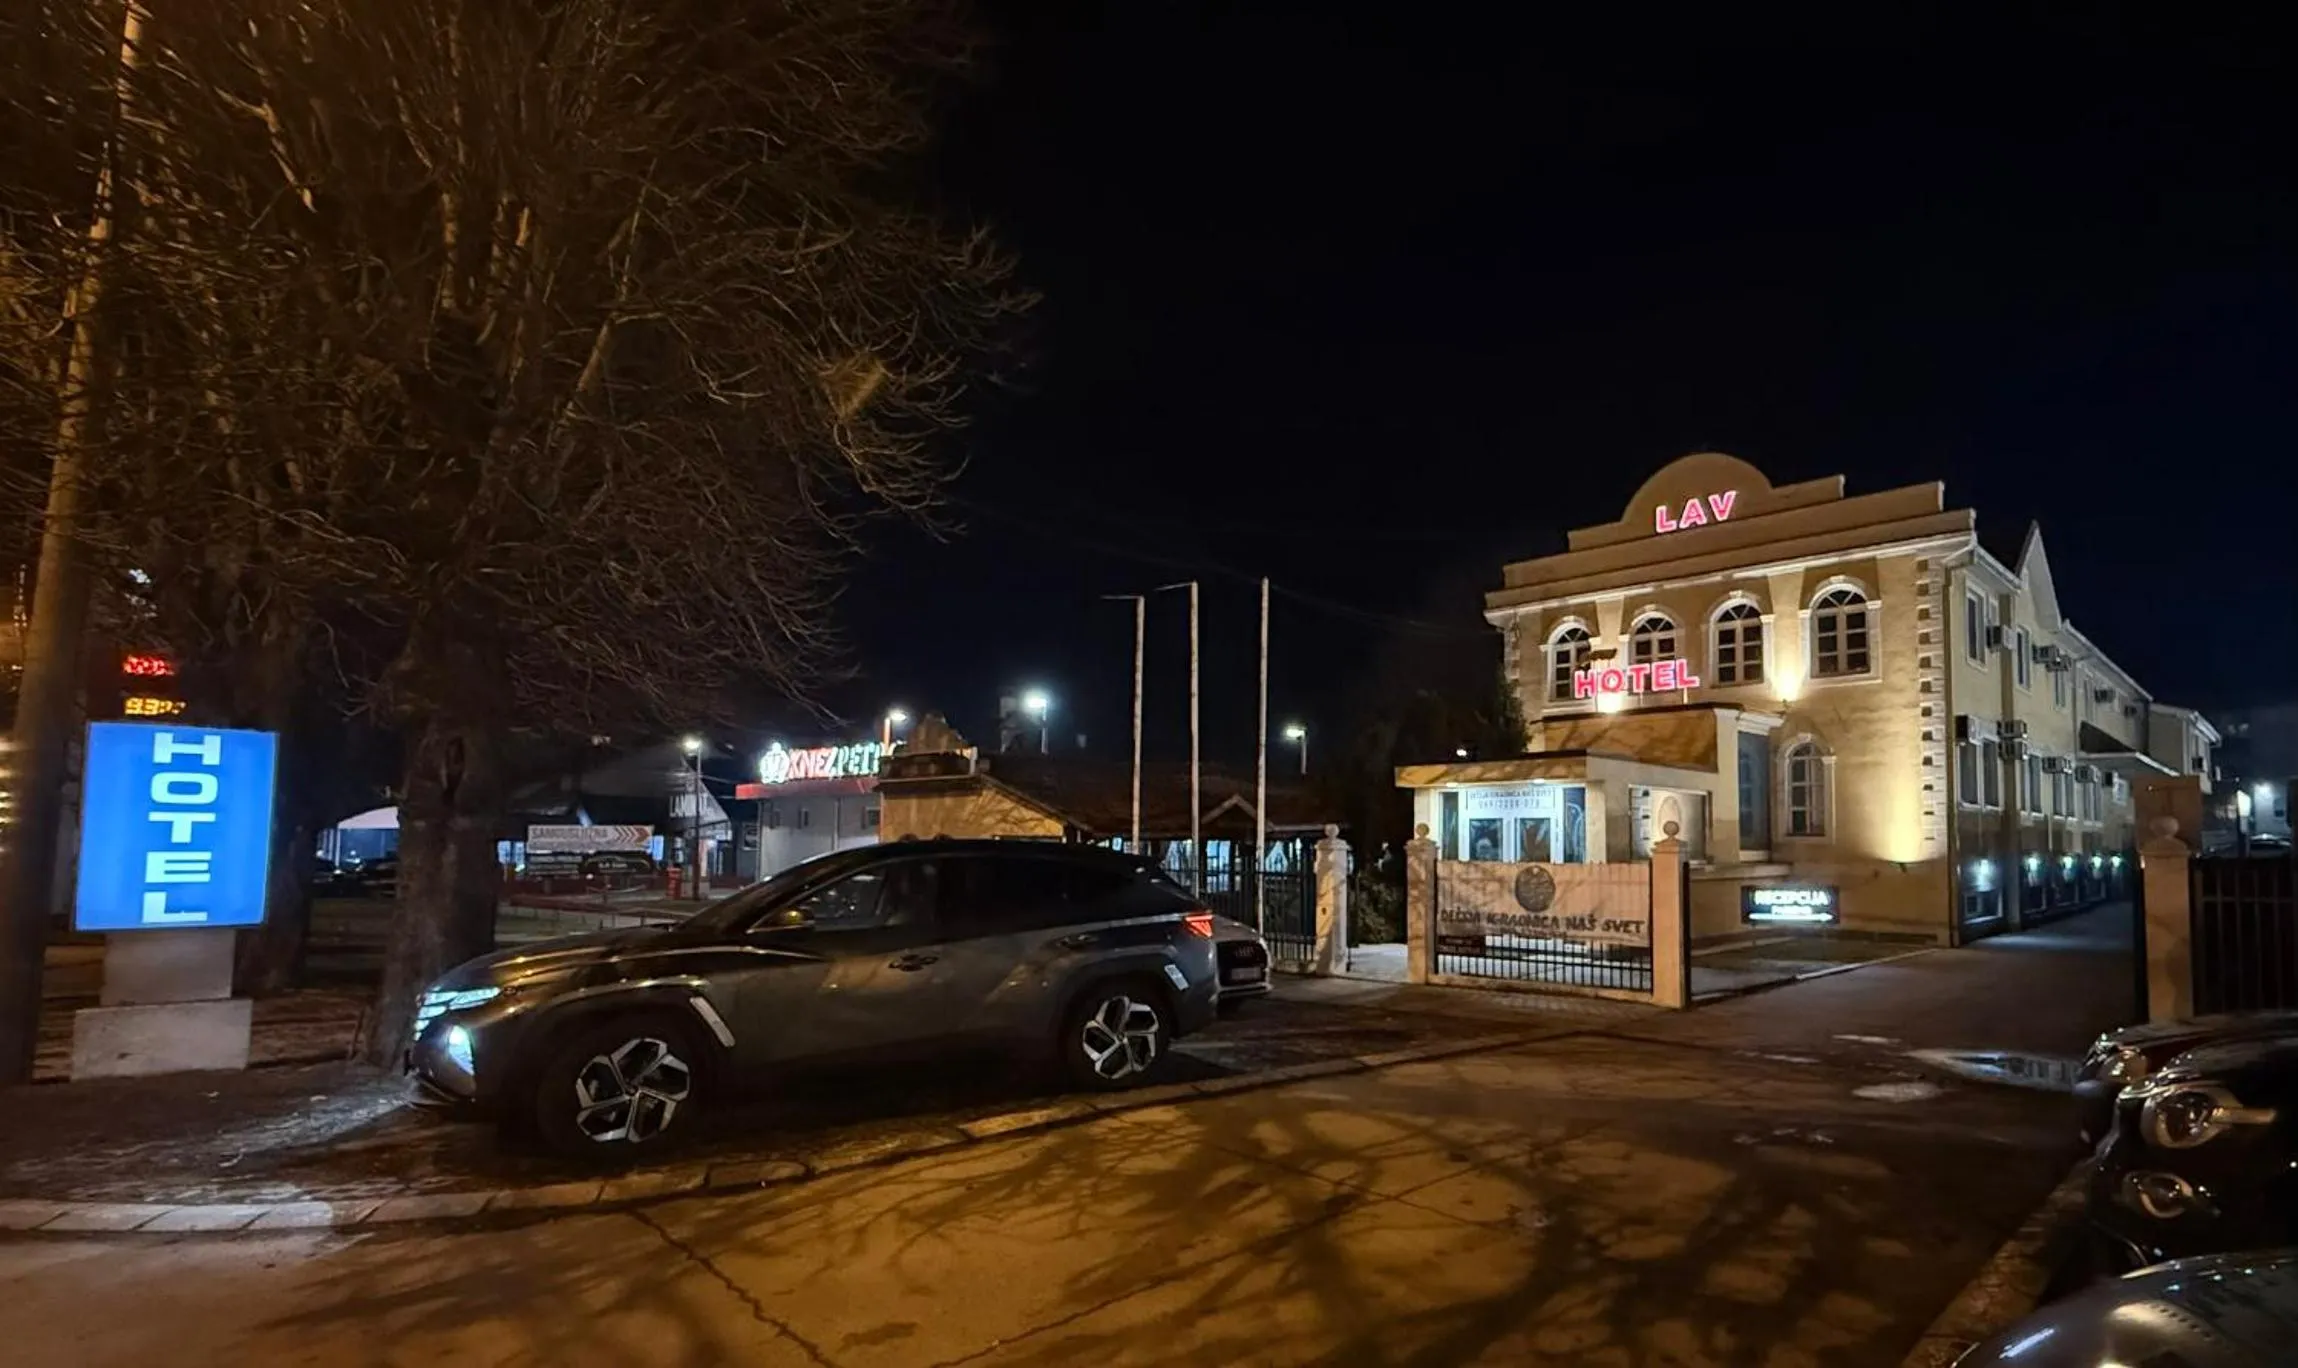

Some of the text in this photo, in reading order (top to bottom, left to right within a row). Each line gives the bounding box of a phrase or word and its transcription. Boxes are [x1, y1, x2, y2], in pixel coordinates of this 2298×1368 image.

[1656, 490, 1736, 533] LAV
[1575, 658, 1700, 699] HOTEL
[142, 732, 222, 924] HOTEL
[1565, 913, 1597, 932] NAŠ
[1601, 919, 1646, 934] SVET
